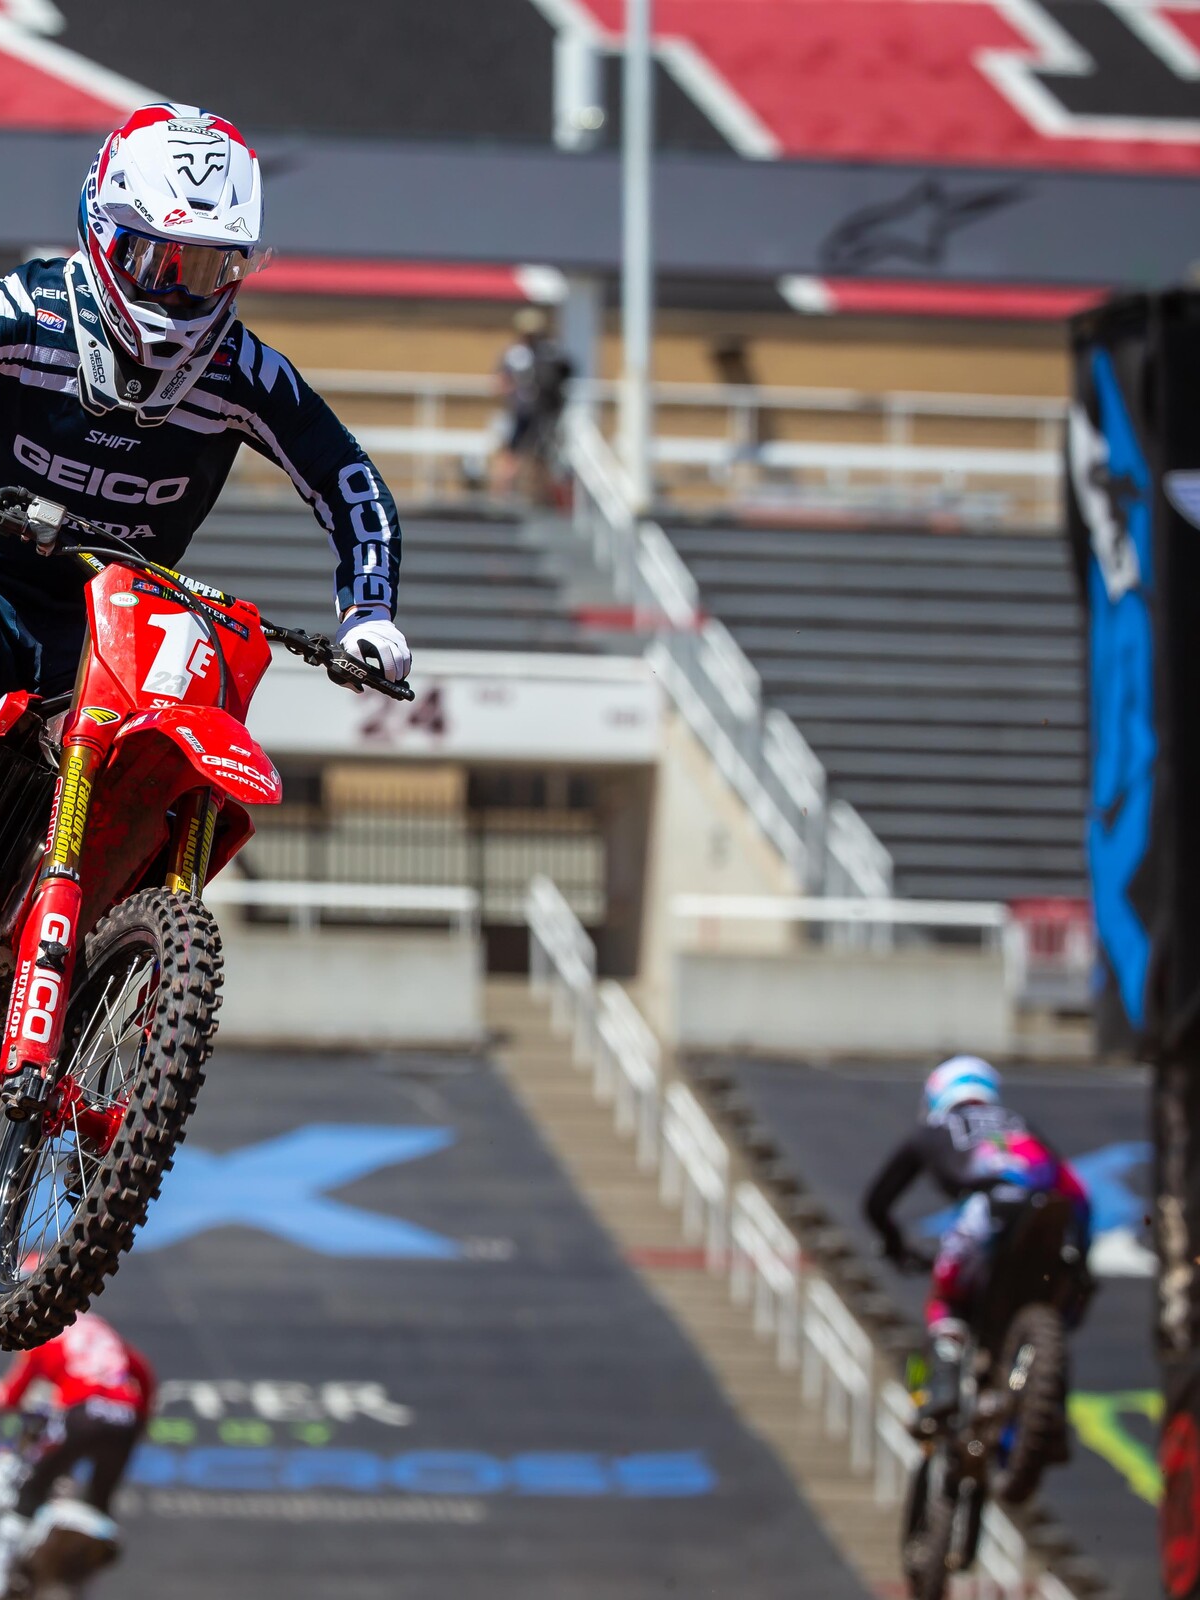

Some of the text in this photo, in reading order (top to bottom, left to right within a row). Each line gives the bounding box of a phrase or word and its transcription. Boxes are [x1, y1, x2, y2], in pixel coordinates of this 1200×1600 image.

[168, 124, 224, 141] HONDA
[36, 310, 62, 330] 100%
[89, 352, 99, 384] HONDA
[93, 349, 106, 384] GEICO
[160, 370, 185, 400] GEICO
[166, 376, 188, 401] HONDA
[84, 429, 141, 452] SHIFT
[13, 433, 190, 506] GEICO
[146, 670, 187, 694] 23
[331, 658, 368, 680] ARC
[202, 755, 276, 791] GEICO
[215, 769, 269, 797] HONDA
[22, 912, 71, 1044] GICO
[9, 960, 32, 1039] DUNLOP
